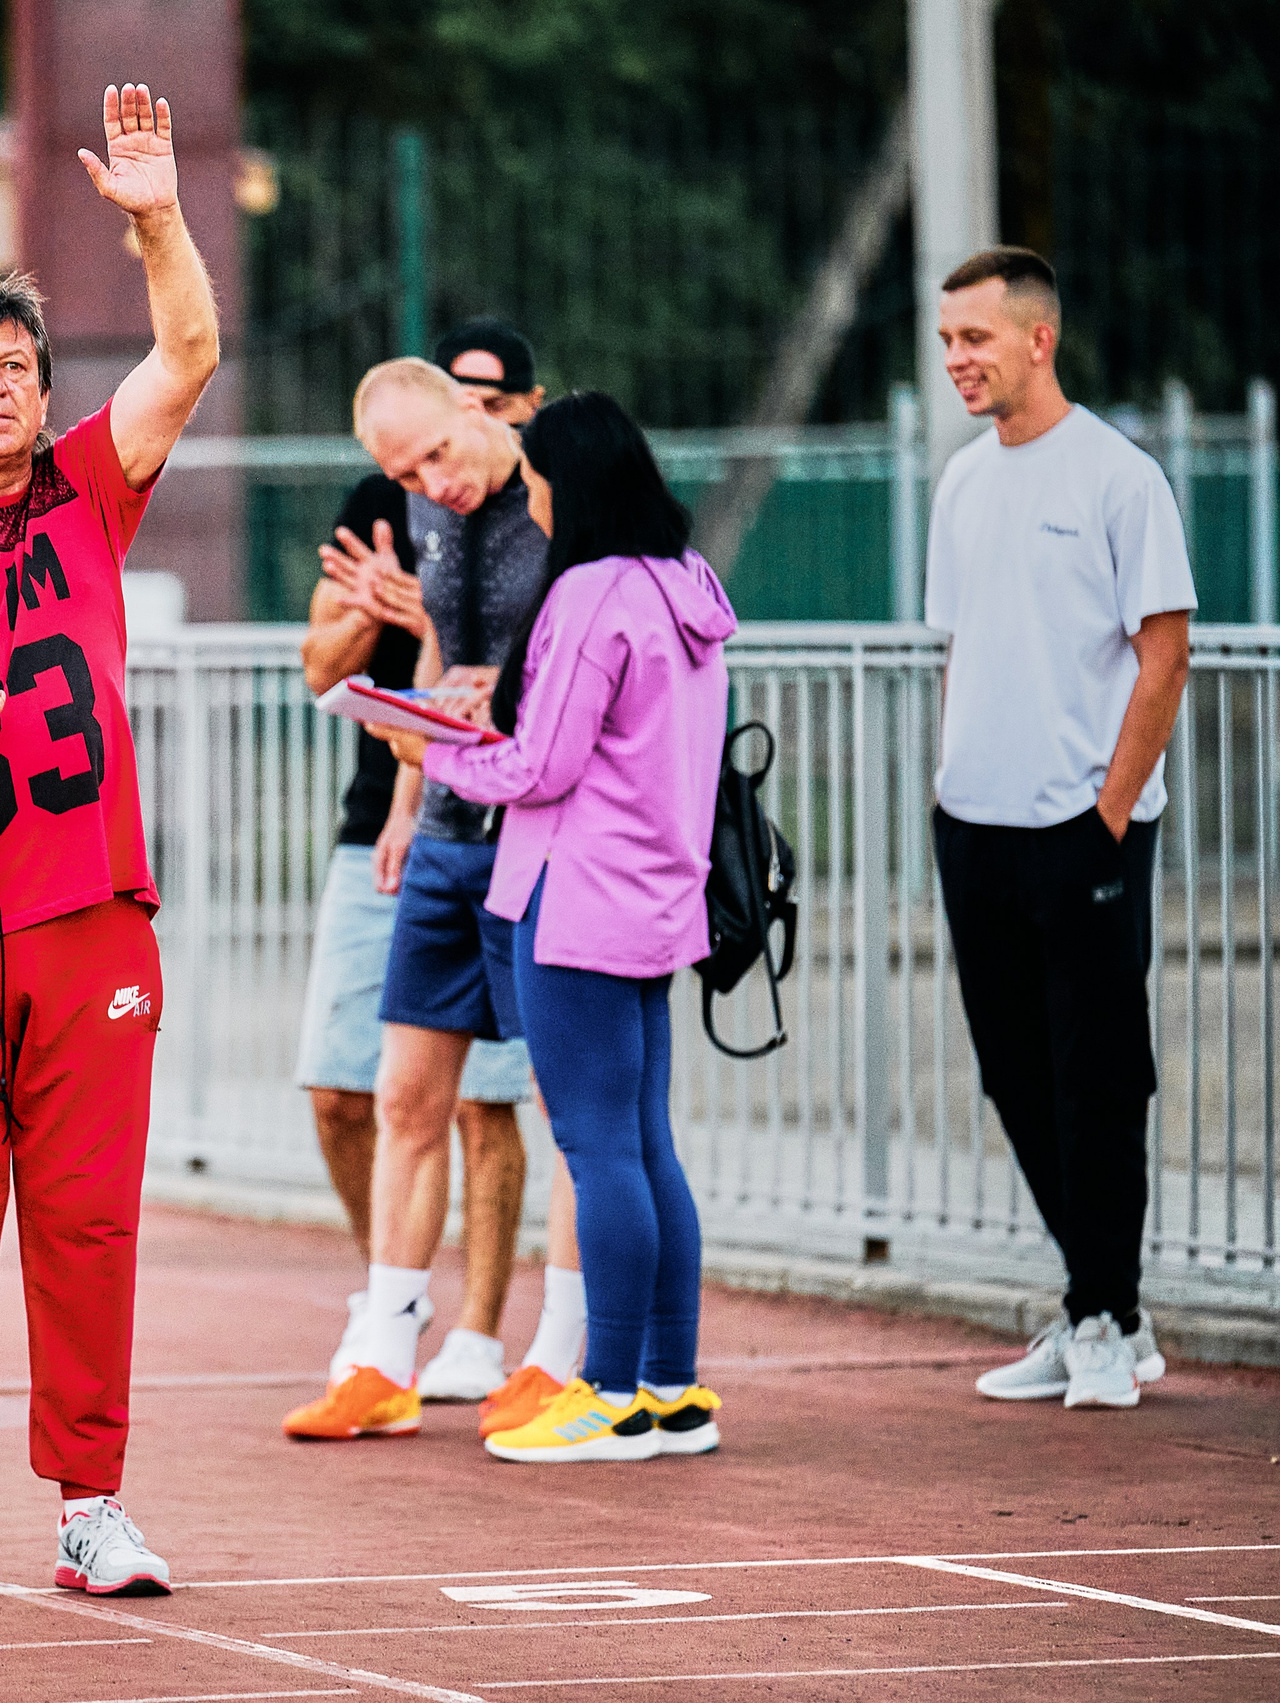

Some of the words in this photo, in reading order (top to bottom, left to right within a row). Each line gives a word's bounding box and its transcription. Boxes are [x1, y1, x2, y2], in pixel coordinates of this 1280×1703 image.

[113, 985, 140, 1007] NIKE
[133, 1000, 151, 1017] AIR
[439, 1580, 713, 1611] 5
